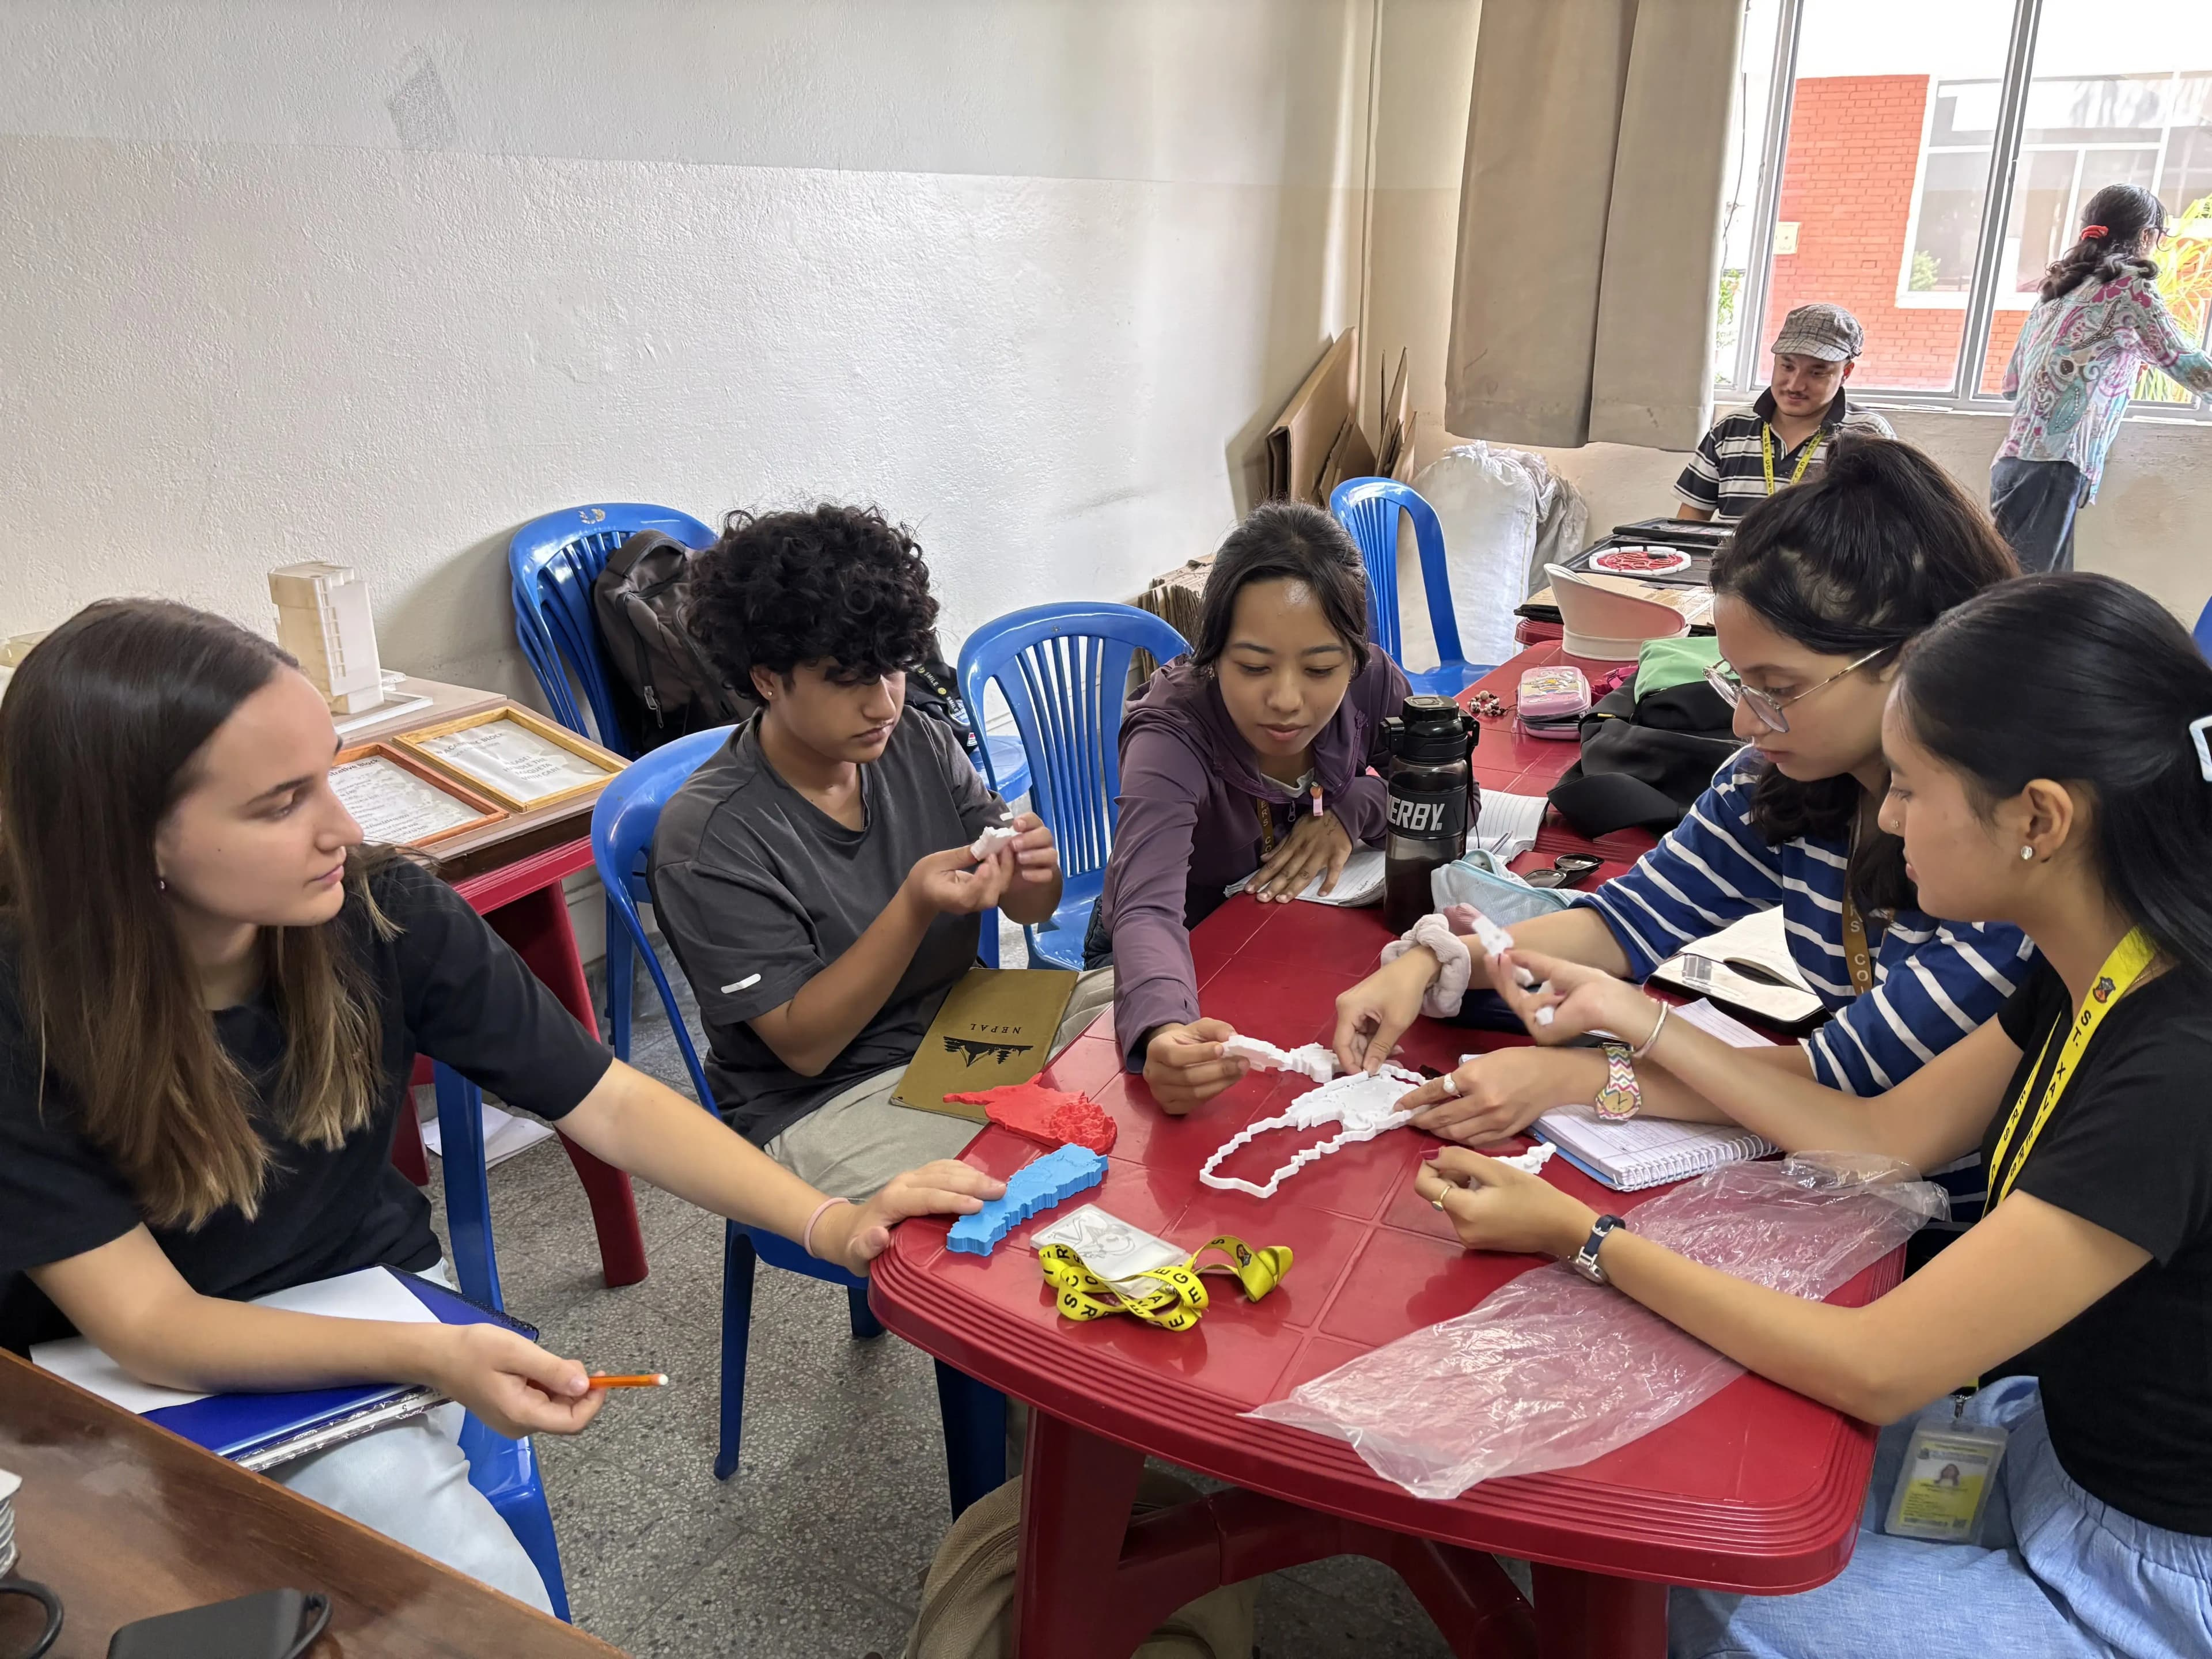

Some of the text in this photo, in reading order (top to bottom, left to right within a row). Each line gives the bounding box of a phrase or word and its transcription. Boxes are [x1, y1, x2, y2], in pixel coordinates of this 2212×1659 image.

[924, 672, 940, 687] SMILE
[946, 696, 959, 713] SMILE
[480, 733, 502, 743] BLOCK
[357, 759, 378, 767] Block
[970, 1023, 1022, 1035] NEPAL
